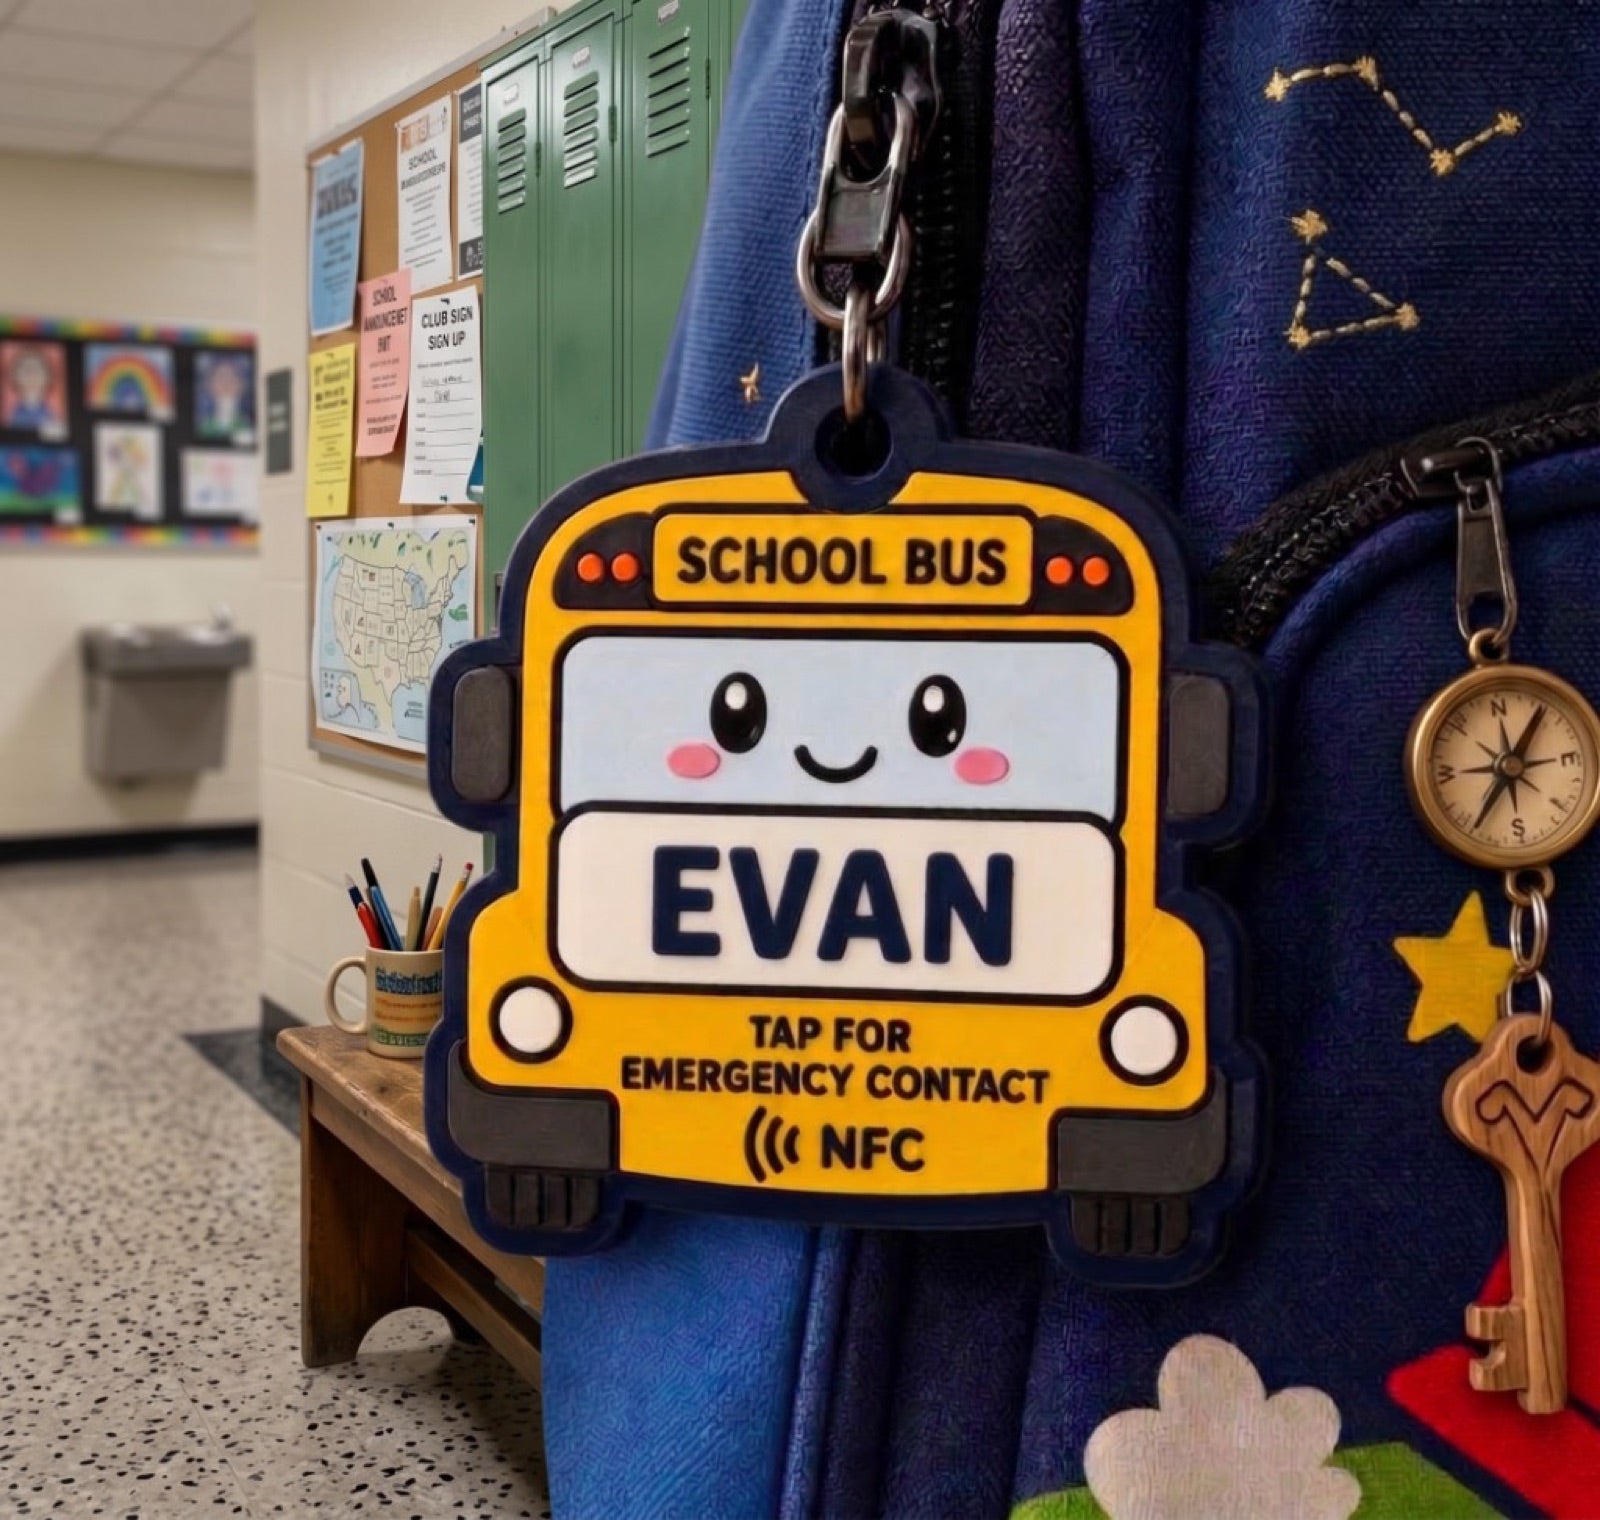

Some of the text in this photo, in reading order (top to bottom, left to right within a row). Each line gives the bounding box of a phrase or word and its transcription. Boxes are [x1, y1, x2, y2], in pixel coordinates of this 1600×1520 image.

[421, 305, 473, 329] CLUB SIGN
[427, 330, 466, 350] SIGN UP
[677, 536, 1007, 586] SCHOOL BUS
[1490, 699, 1508, 717] N
[1560, 750, 1575, 767] E
[1437, 764, 1456, 784] W
[1511, 817, 1526, 838] S
[652, 845, 1014, 967] EVAN
[749, 1014, 912, 1053] TAP FOR
[620, 1056, 1050, 1104] EMERGENCY CONTACT
[820, 1122, 925, 1173] NFC
